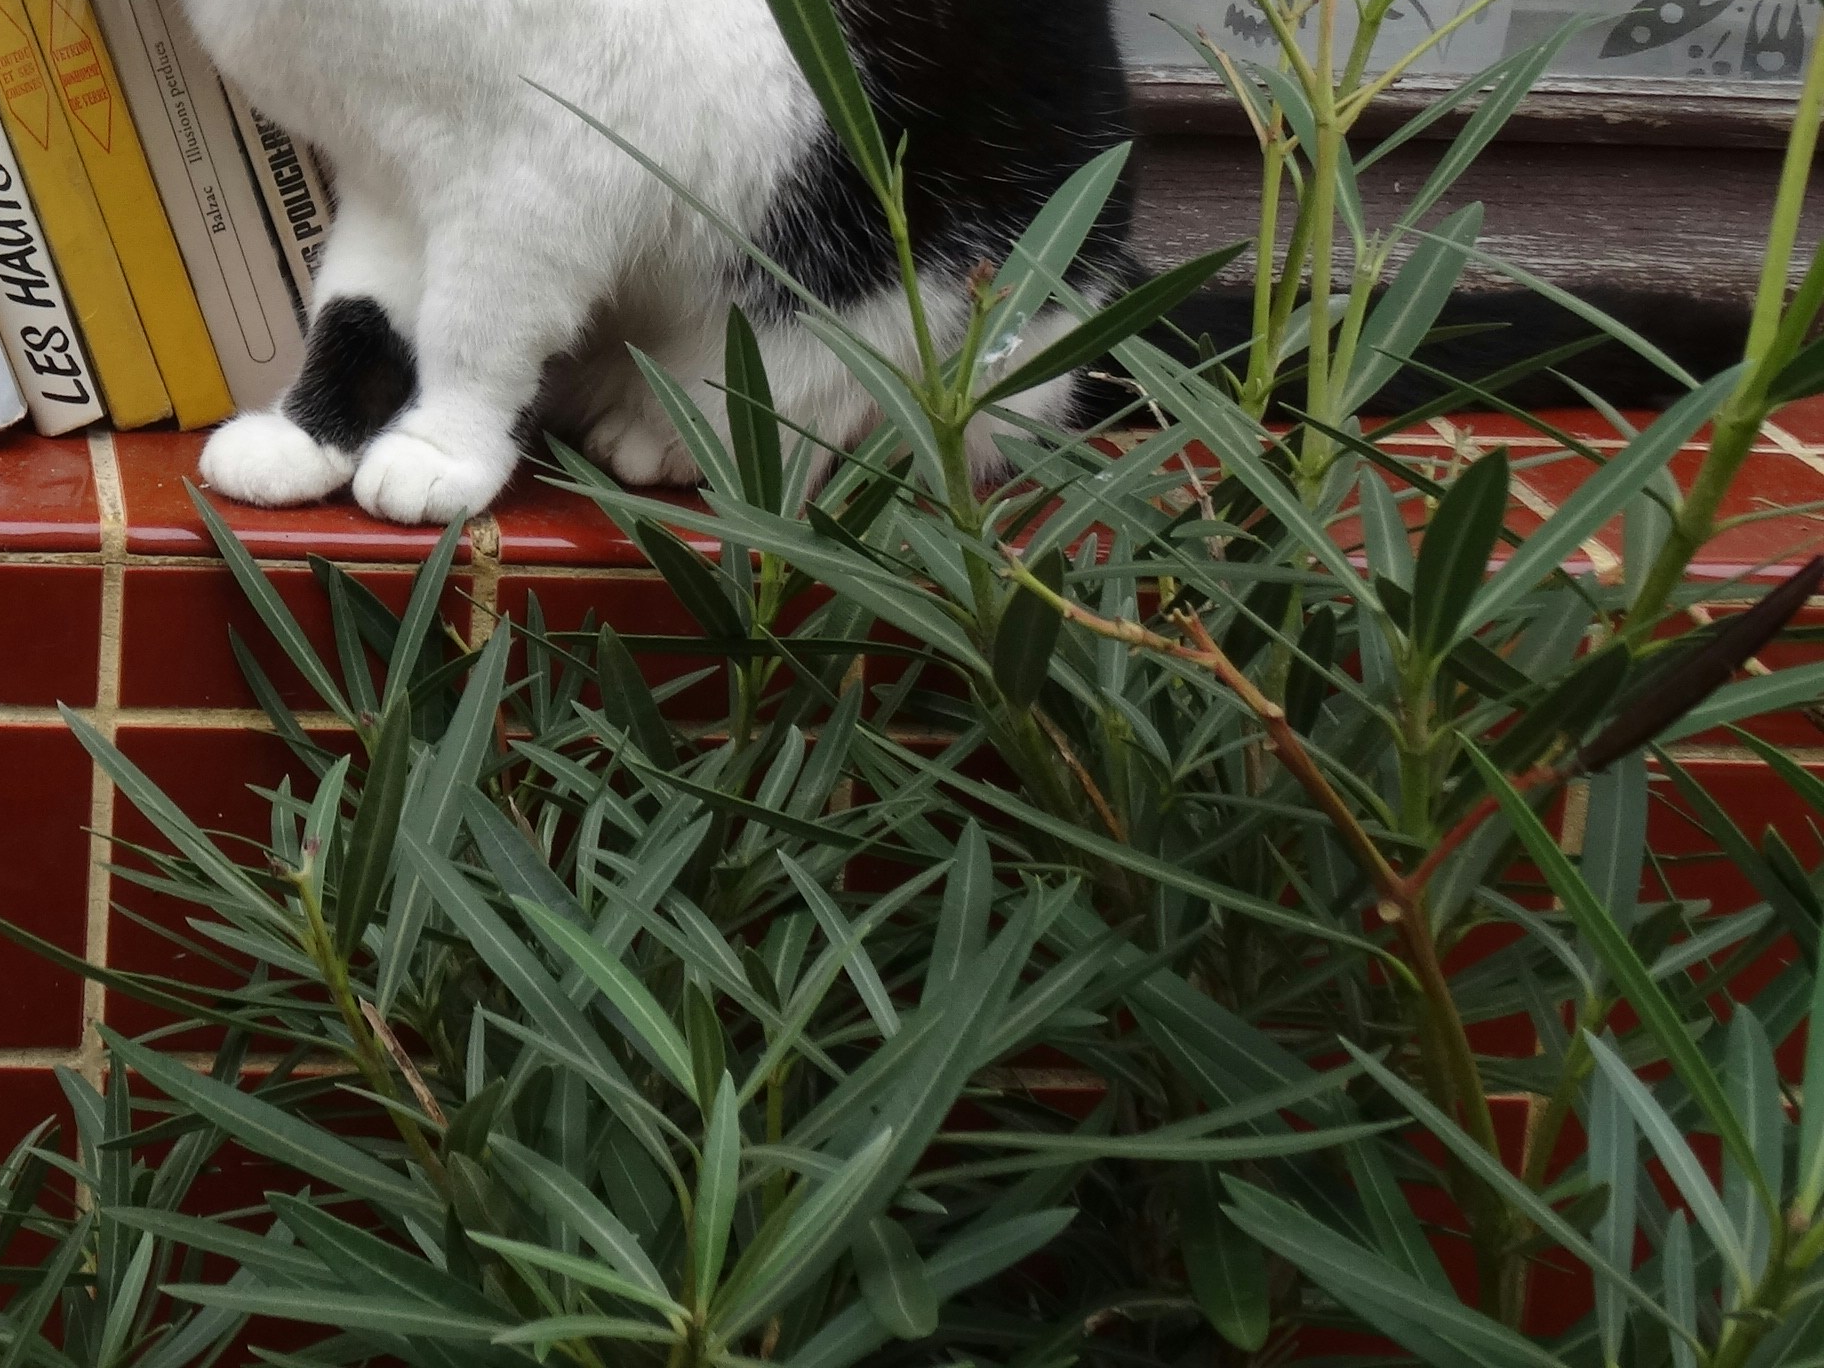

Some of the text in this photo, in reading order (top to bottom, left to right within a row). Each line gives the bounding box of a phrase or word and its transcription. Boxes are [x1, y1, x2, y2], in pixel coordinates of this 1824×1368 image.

[155, 40, 226, 234] Balzac Illusions perdues
[20, 324, 91, 407] LES
